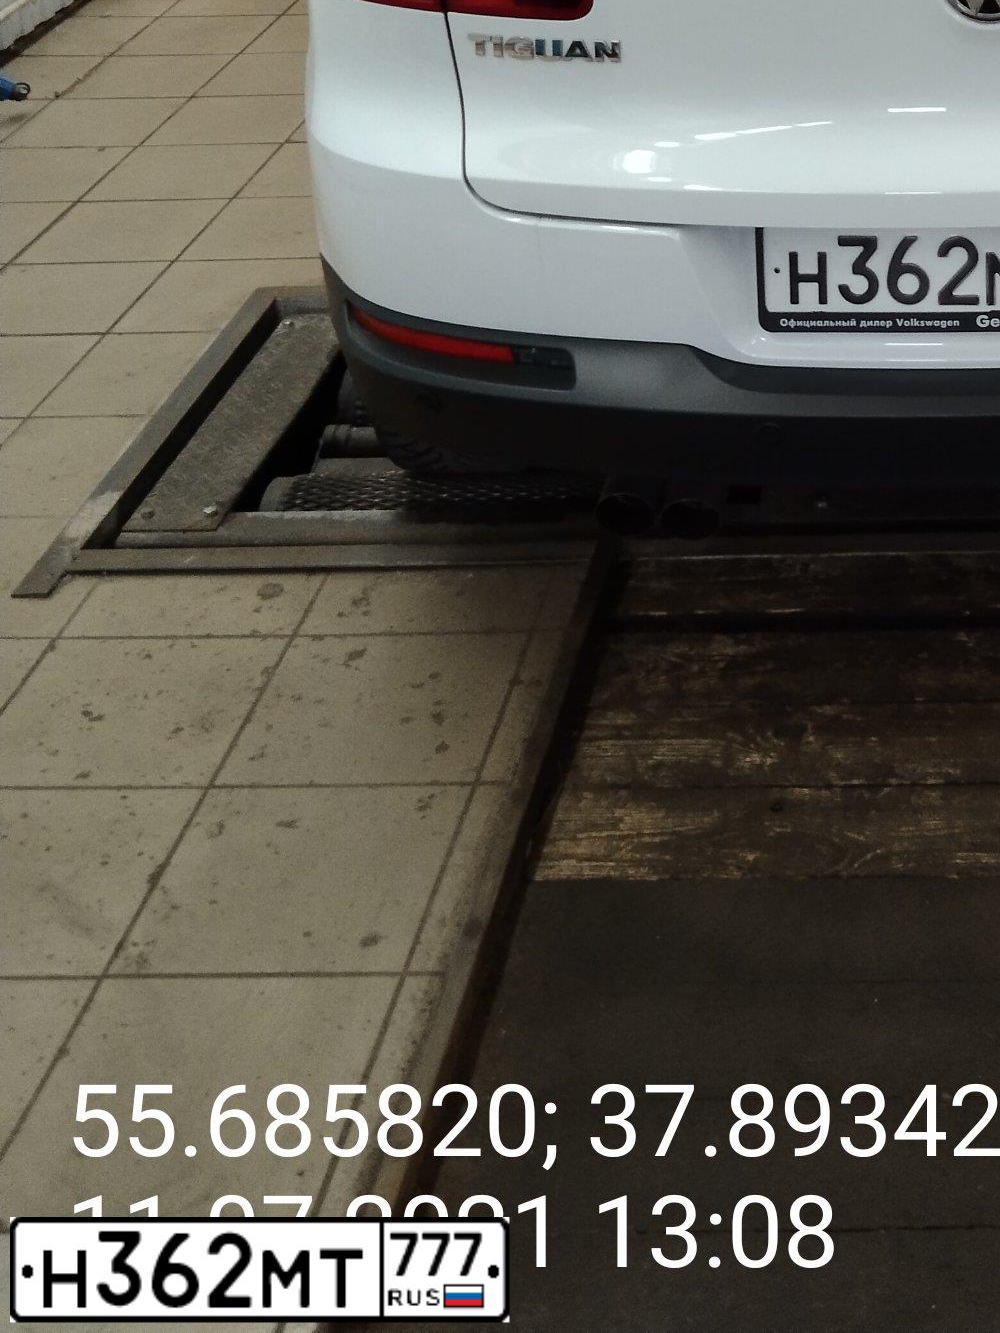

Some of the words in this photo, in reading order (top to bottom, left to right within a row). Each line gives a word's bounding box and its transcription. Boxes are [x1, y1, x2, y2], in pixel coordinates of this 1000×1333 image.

[467, 32, 622, 63] TIGUAN
[779, 318, 857, 328] Официальный
[859, 318, 893, 329] дилер
[896, 317, 960, 328] Volkswagen
